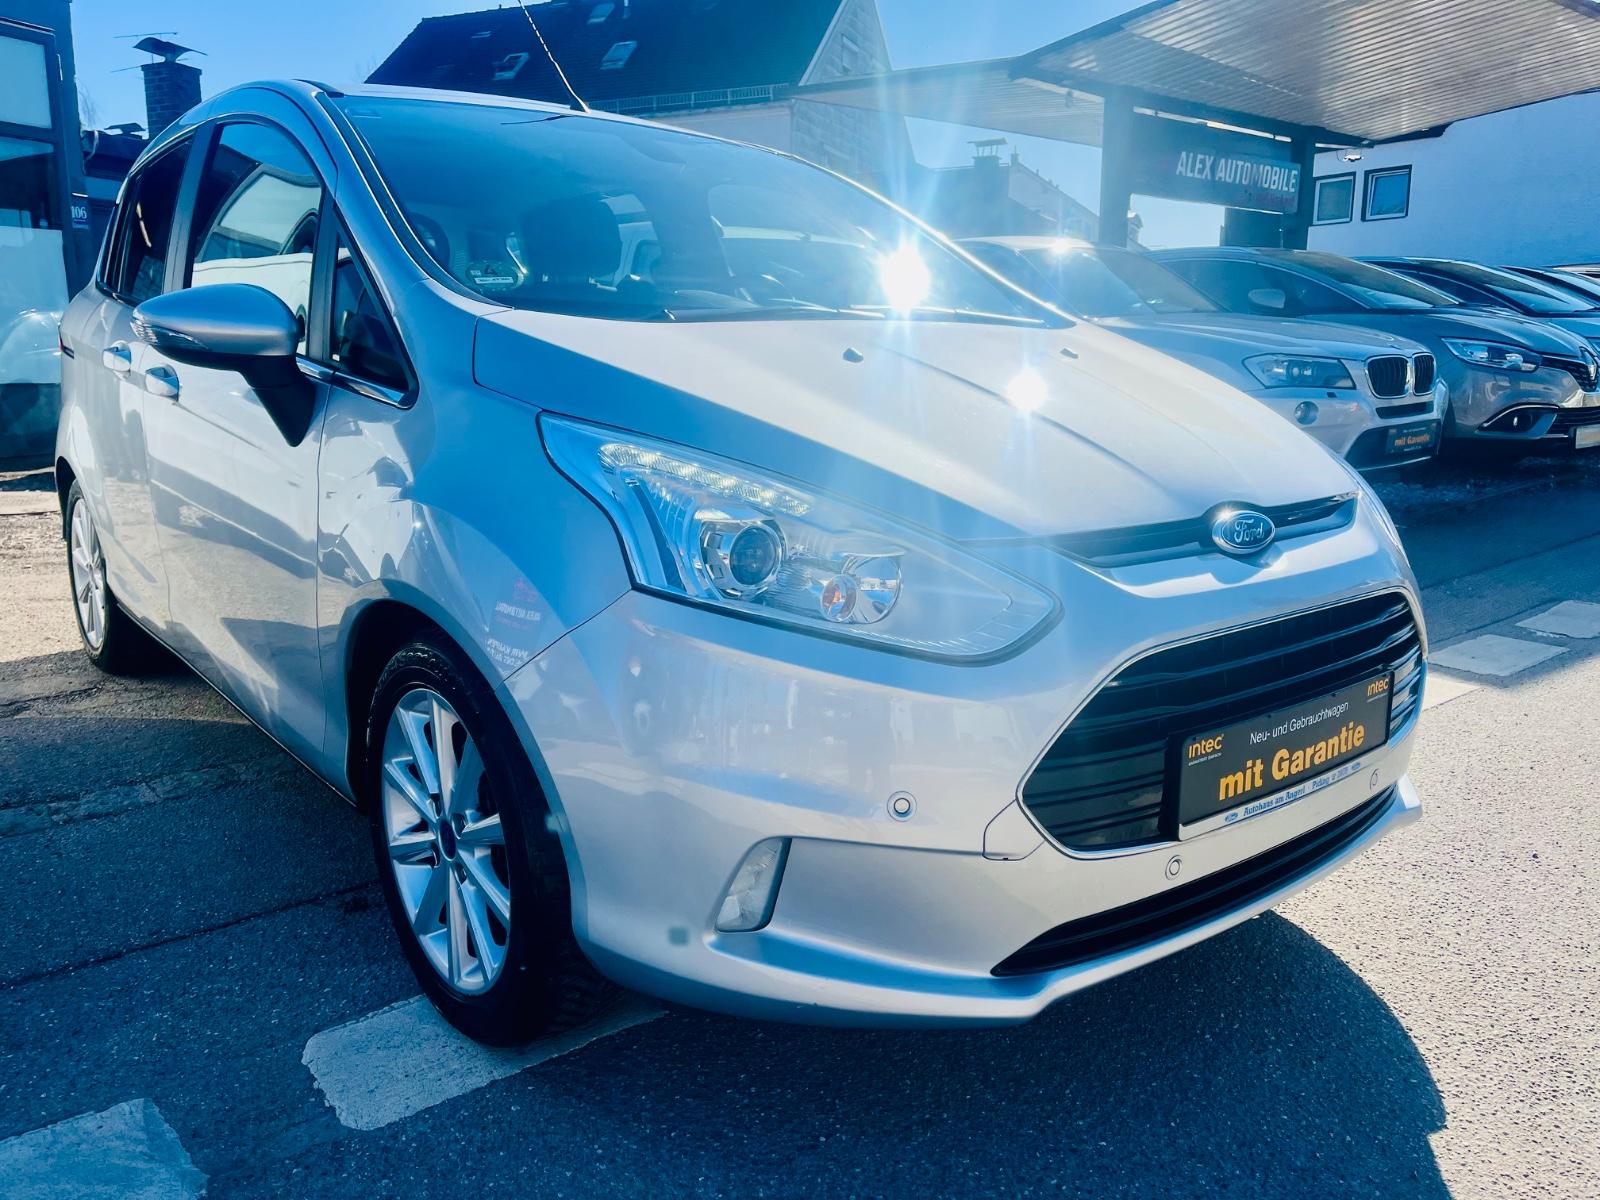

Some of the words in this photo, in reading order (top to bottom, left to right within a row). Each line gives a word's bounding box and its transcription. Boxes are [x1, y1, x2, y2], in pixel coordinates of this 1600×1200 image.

[1176, 151, 1215, 180] ALEX
[1216, 158, 1298, 192] AUTOMOBILE
[70, 205, 86, 219] 106
[1234, 519, 1264, 543] Ford
[1249, 731, 1271, 745] Neu-
[1272, 722, 1288, 738] und
[1289, 701, 1349, 731] Gebrauchtwagen
[1219, 759, 1264, 801] mit
[1271, 721, 1365, 782] Garantie
[1243, 799, 1274, 817] Autohaus
